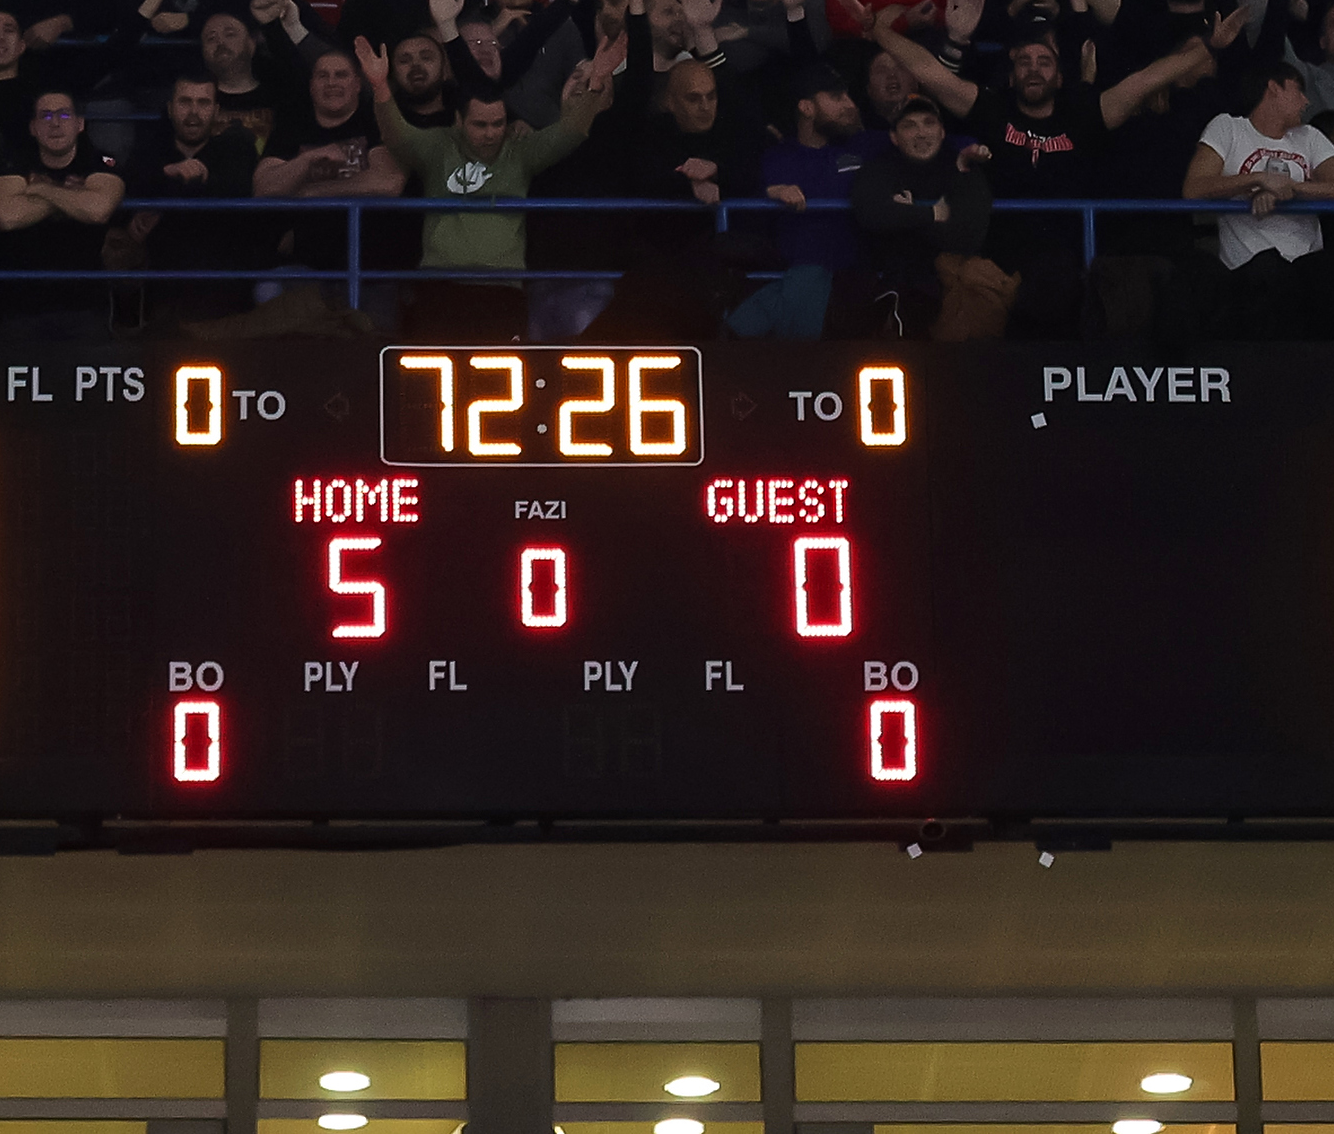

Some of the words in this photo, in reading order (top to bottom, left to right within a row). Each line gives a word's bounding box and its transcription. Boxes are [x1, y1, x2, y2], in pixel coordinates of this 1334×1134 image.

[9, 367, 54, 402] FL
[76, 367, 146, 403] PTS
[1044, 367, 1232, 403] PLAYER
[176, 366, 223, 447] 0
[233, 391, 287, 420] TO
[400, 355, 687, 458] 72:26
[789, 392, 844, 422] TO
[859, 367, 907, 447] 0
[295, 476, 420, 525] HOME
[515, 501, 568, 521] FAZI
[707, 478, 850, 525] GUEST
[329, 535, 387, 639] 5
[520, 547, 567, 628] 0
[793, 536, 853, 638] 0
[170, 662, 225, 693] BO
[305, 662, 360, 693] PLY
[430, 661, 469, 692] FL
[585, 662, 639, 692] PLY
[706, 662, 745, 692] FL
[865, 662, 920, 693] BO
[174, 699, 221, 783] 0
[869, 700, 917, 782] 0
